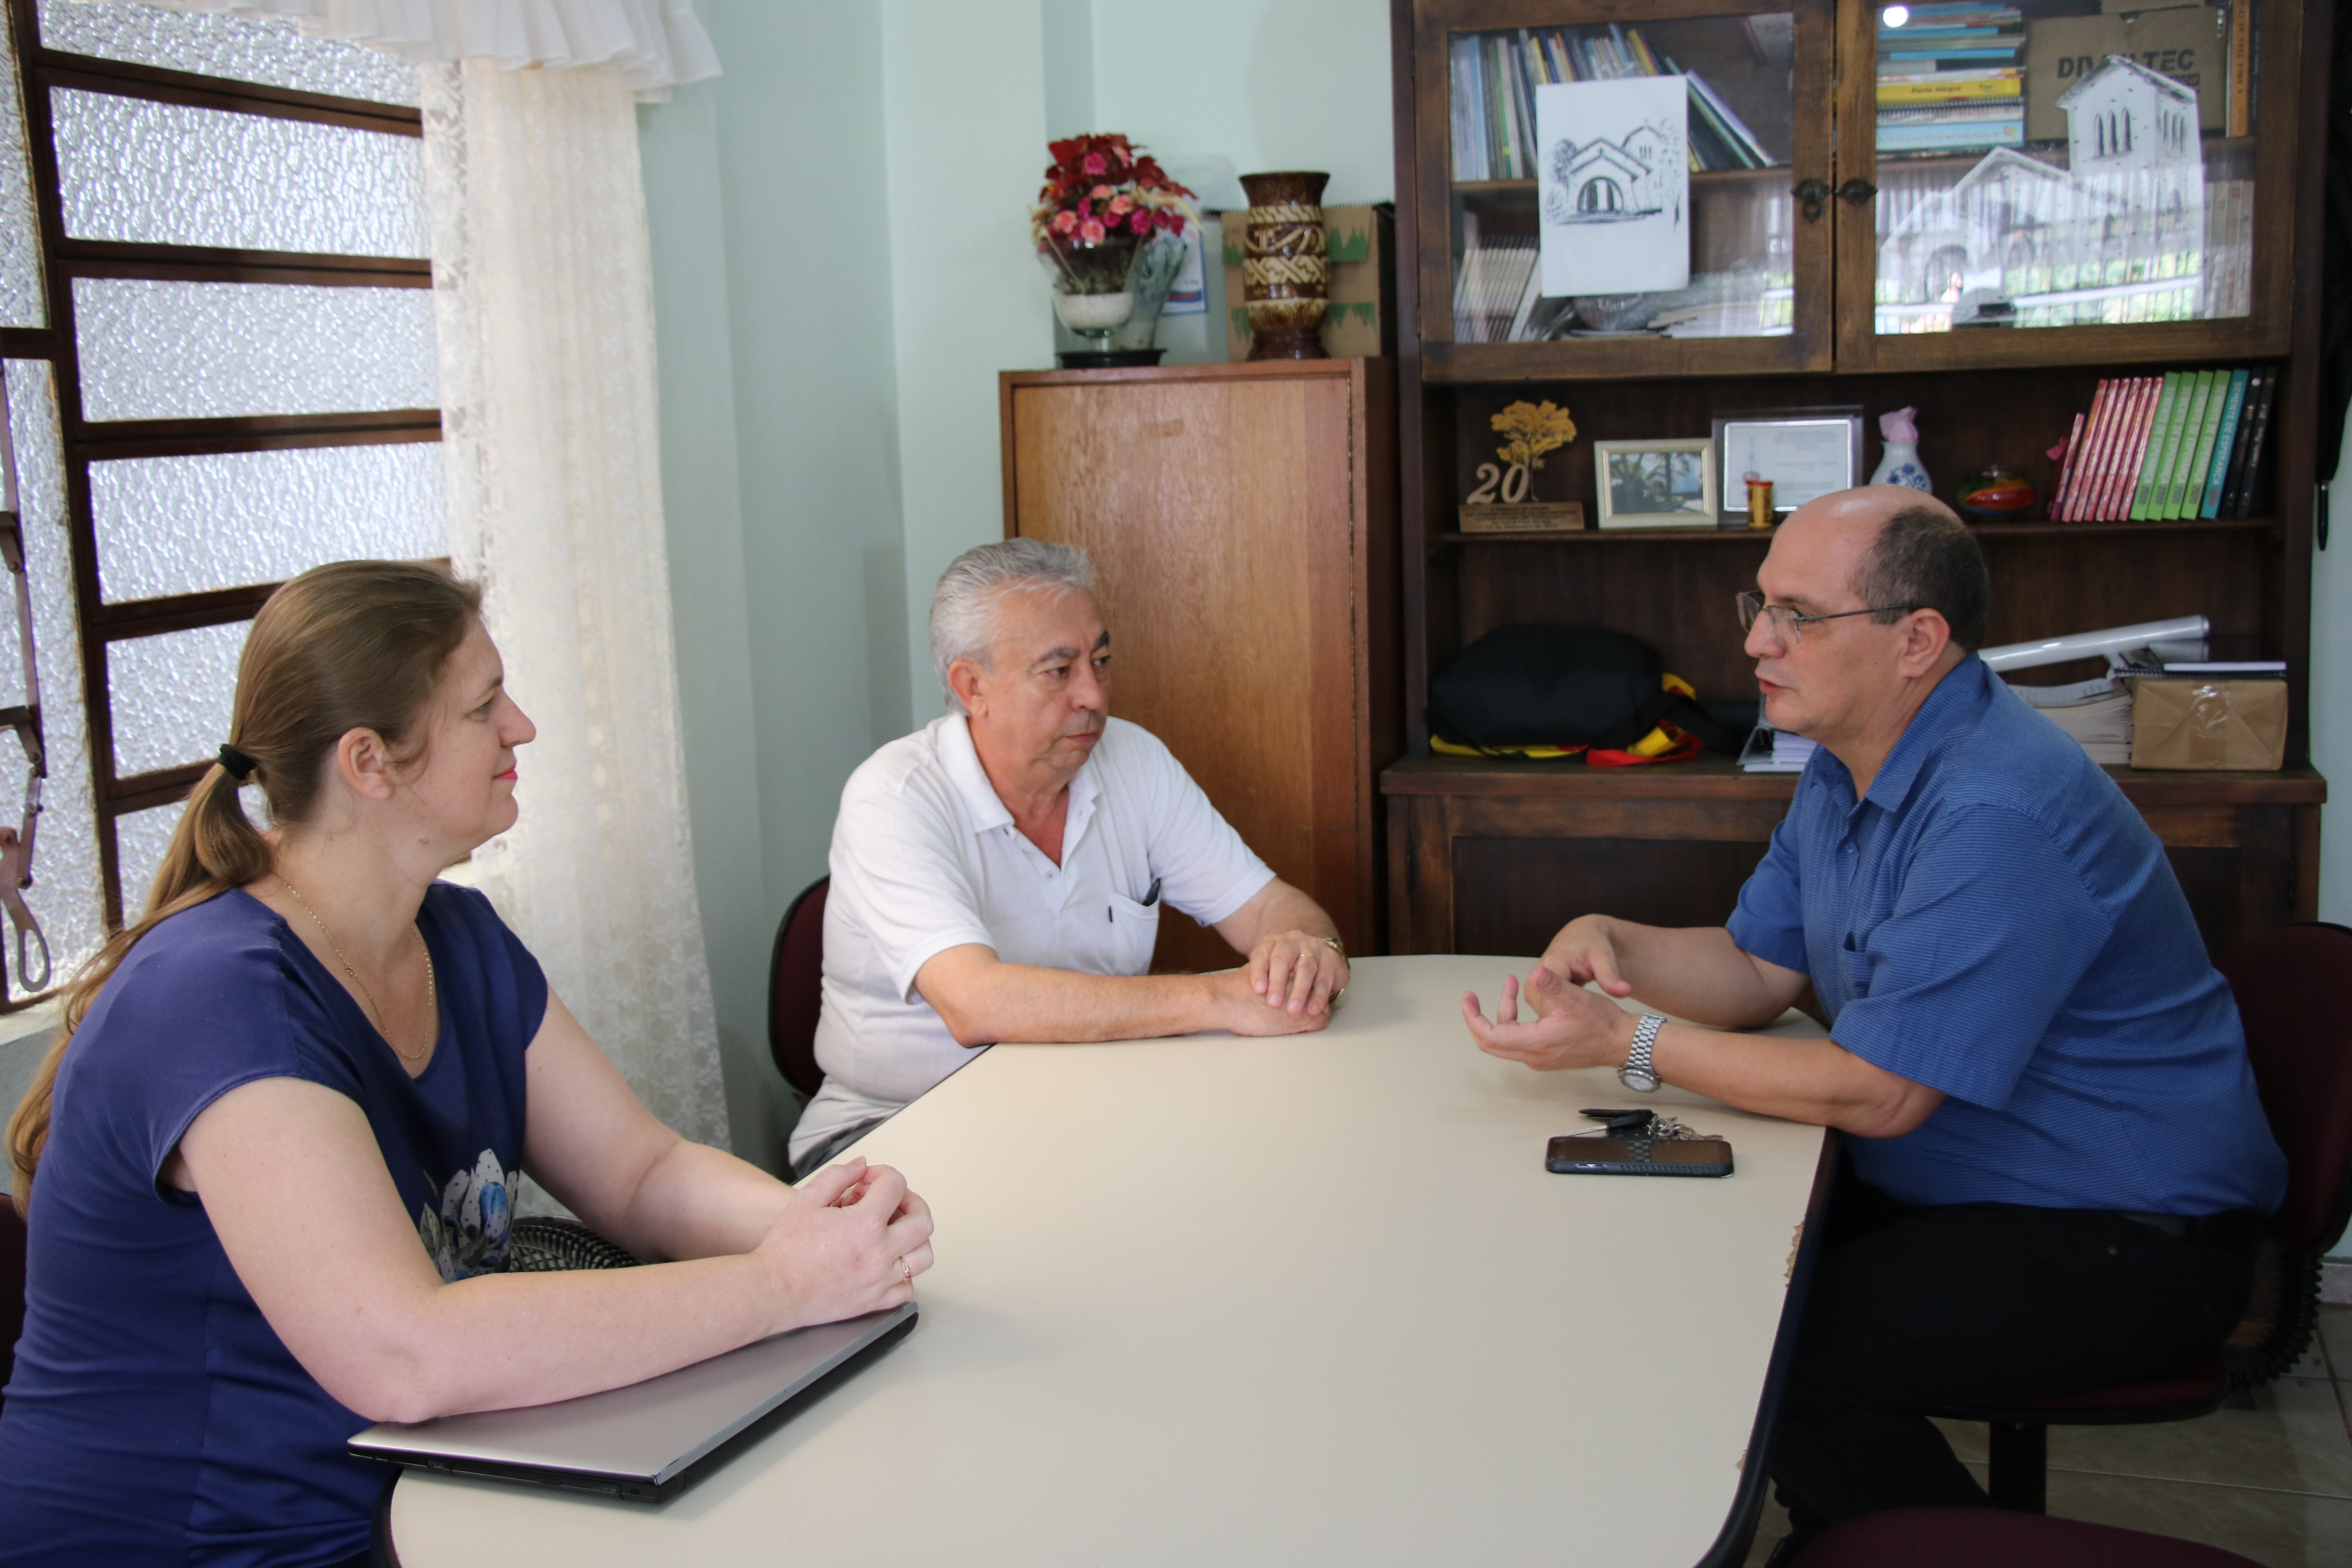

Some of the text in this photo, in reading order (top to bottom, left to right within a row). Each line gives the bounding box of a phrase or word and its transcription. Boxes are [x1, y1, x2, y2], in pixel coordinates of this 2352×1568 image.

[2227, 381, 2242, 419] SEMENTE
[2223, 422, 2234, 433] DE
[2212, 435, 2230, 485] ESPERANÇA
[1466, 462, 1529, 505] 20
